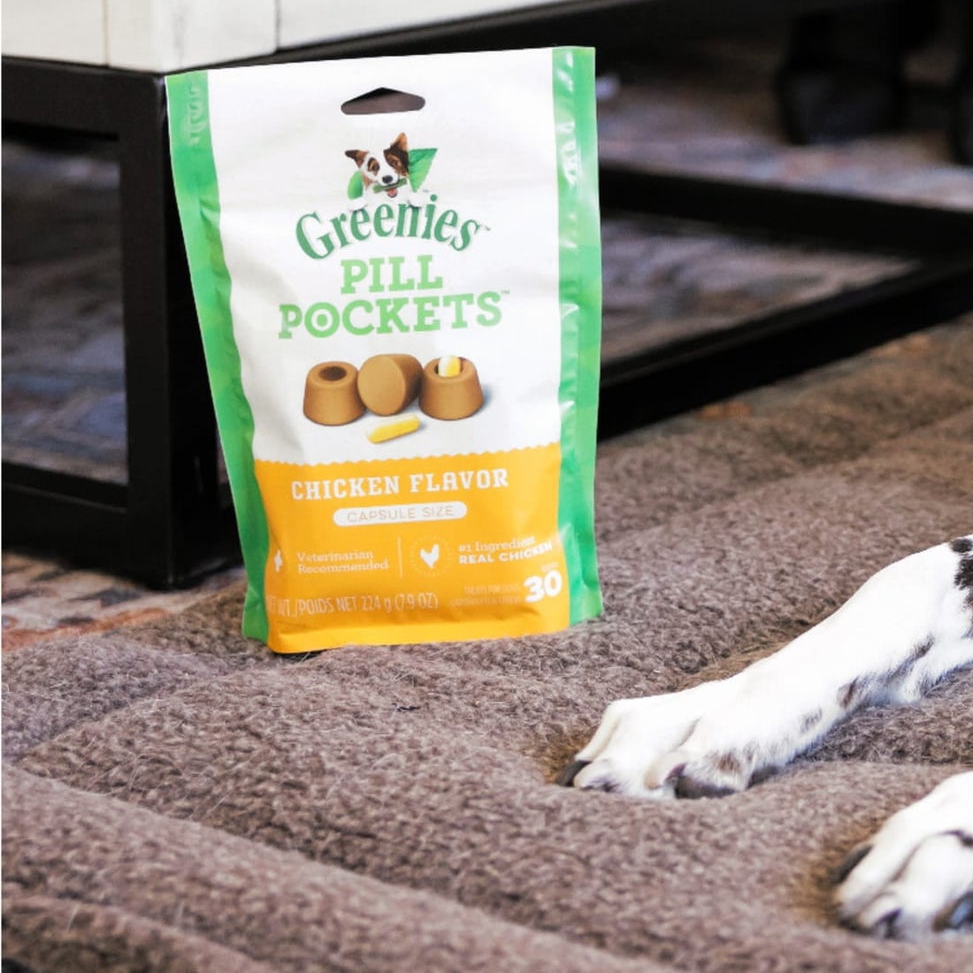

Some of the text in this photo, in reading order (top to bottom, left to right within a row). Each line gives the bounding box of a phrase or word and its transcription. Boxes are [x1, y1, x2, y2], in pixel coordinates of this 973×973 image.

[295, 194, 481, 260] Greenies
[341, 254, 443, 294] PILL
[278, 291, 502, 339] POCKETS
[291, 468, 509, 500] CHICKEN FLAVOR
[347, 505, 454, 523] CAPSULE SIZE
[297, 551, 374, 563] Veterinarian
[459, 541, 553, 564] REAL CHICKEN
[298, 559, 389, 574] Recommended
[523, 569, 562, 603] 30
[336, 595, 357, 612] NET
[361, 595, 381, 611] 224
